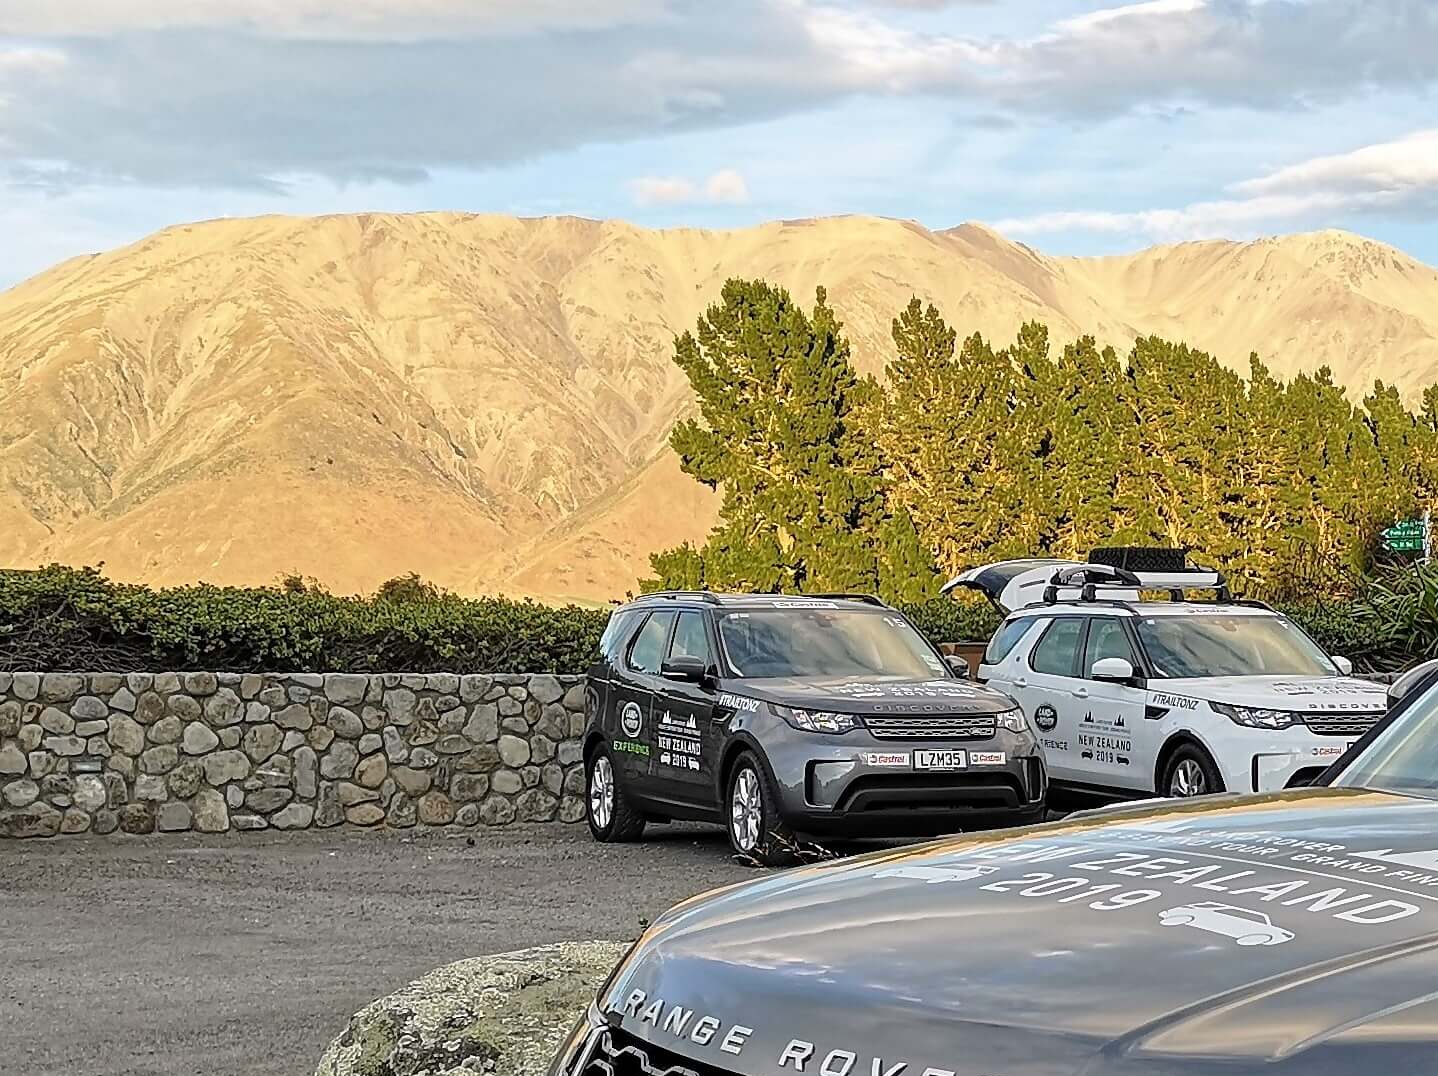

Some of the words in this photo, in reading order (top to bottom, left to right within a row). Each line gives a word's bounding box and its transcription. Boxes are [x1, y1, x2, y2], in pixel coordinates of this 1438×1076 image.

[1152, 694, 1199, 711] #TRAILTONZ
[658, 736, 671, 750] NEW
[672, 738, 701, 756] ZEALAND
[1078, 734, 1094, 747] NEW
[1096, 736, 1132, 751] ZEALAND
[672, 753, 687, 768] 2019
[920, 752, 961, 767] LZM35
[1096, 750, 1114, 763] 2019
[1256, 834, 1346, 854] ROVER
[1210, 841, 1280, 856] TOUR
[1289, 852, 1388, 874] GRAND
[978, 872, 1163, 911] 2019
[1068, 852, 1422, 925] ZEALAND
[624, 988, 754, 1055] RANGE
